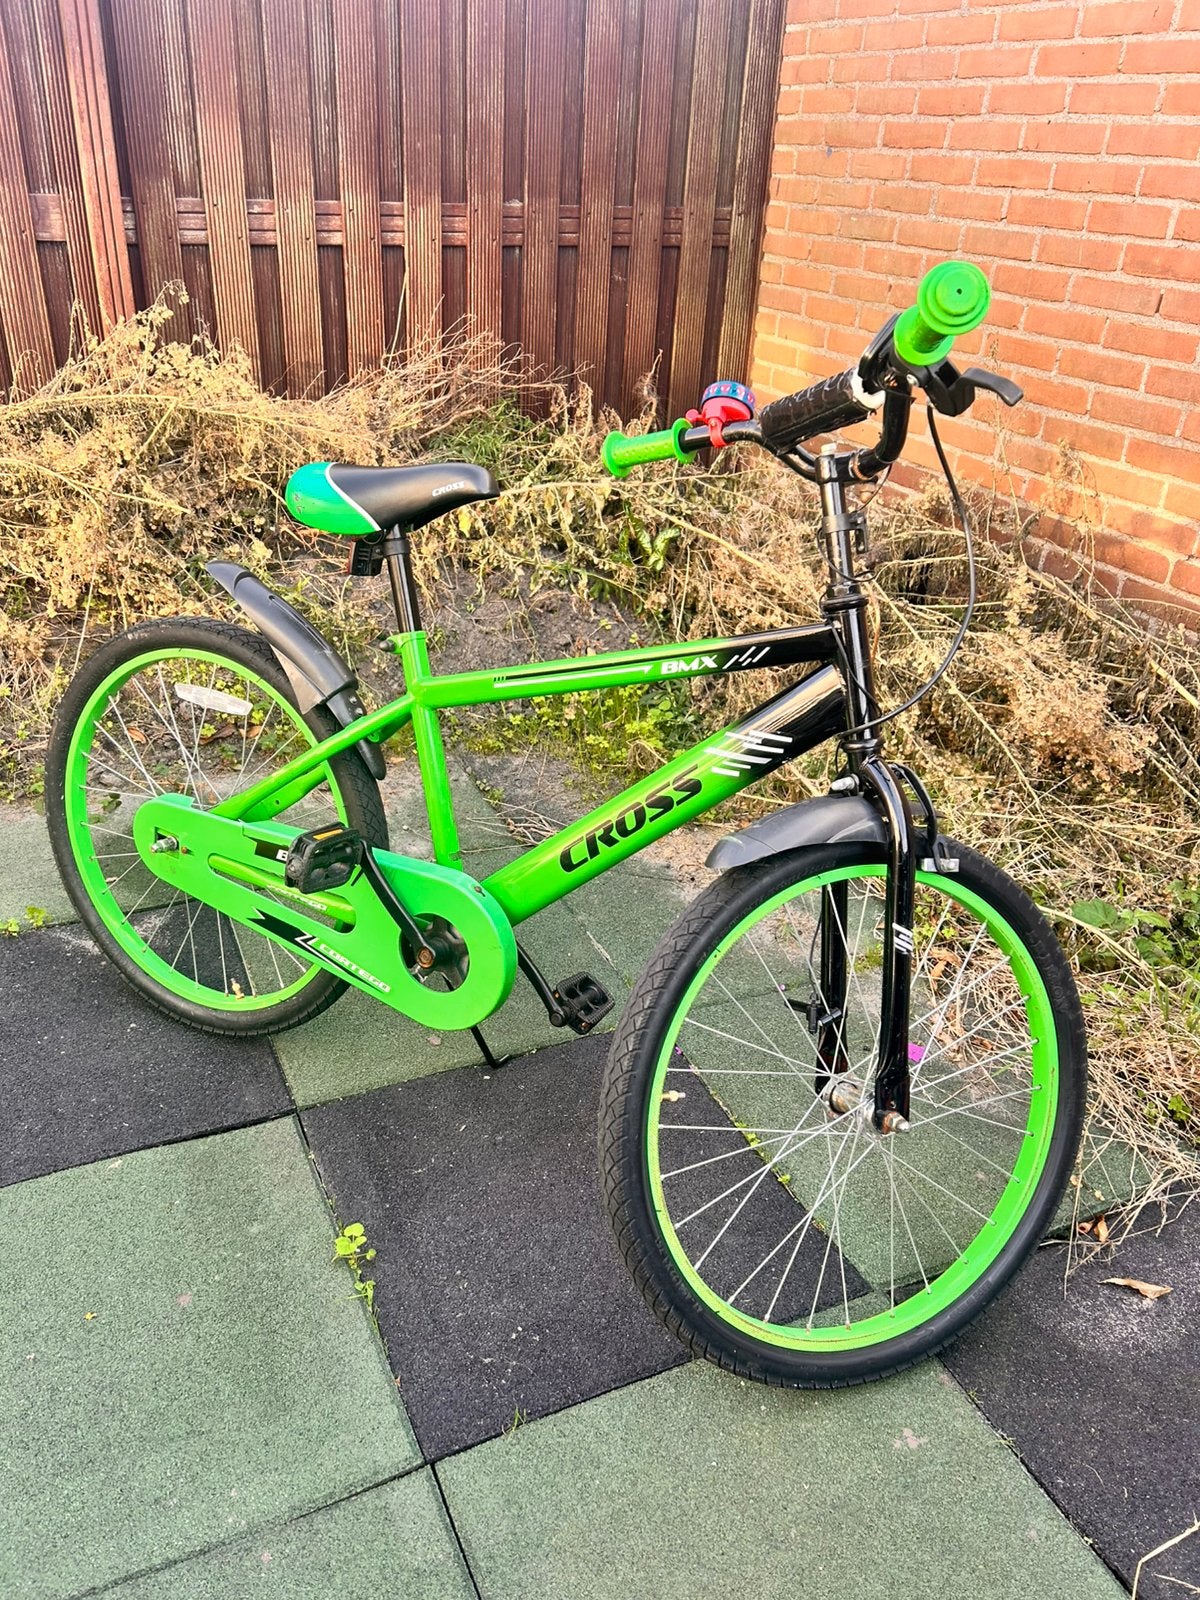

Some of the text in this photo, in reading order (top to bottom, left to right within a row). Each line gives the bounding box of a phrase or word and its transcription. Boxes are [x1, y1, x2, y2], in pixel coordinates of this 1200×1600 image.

[432, 481, 465, 497] CROSS
[660, 654, 718, 675] BMX
[559, 764, 703, 873] CROSS
[319, 943, 391, 993] CORTEGO
